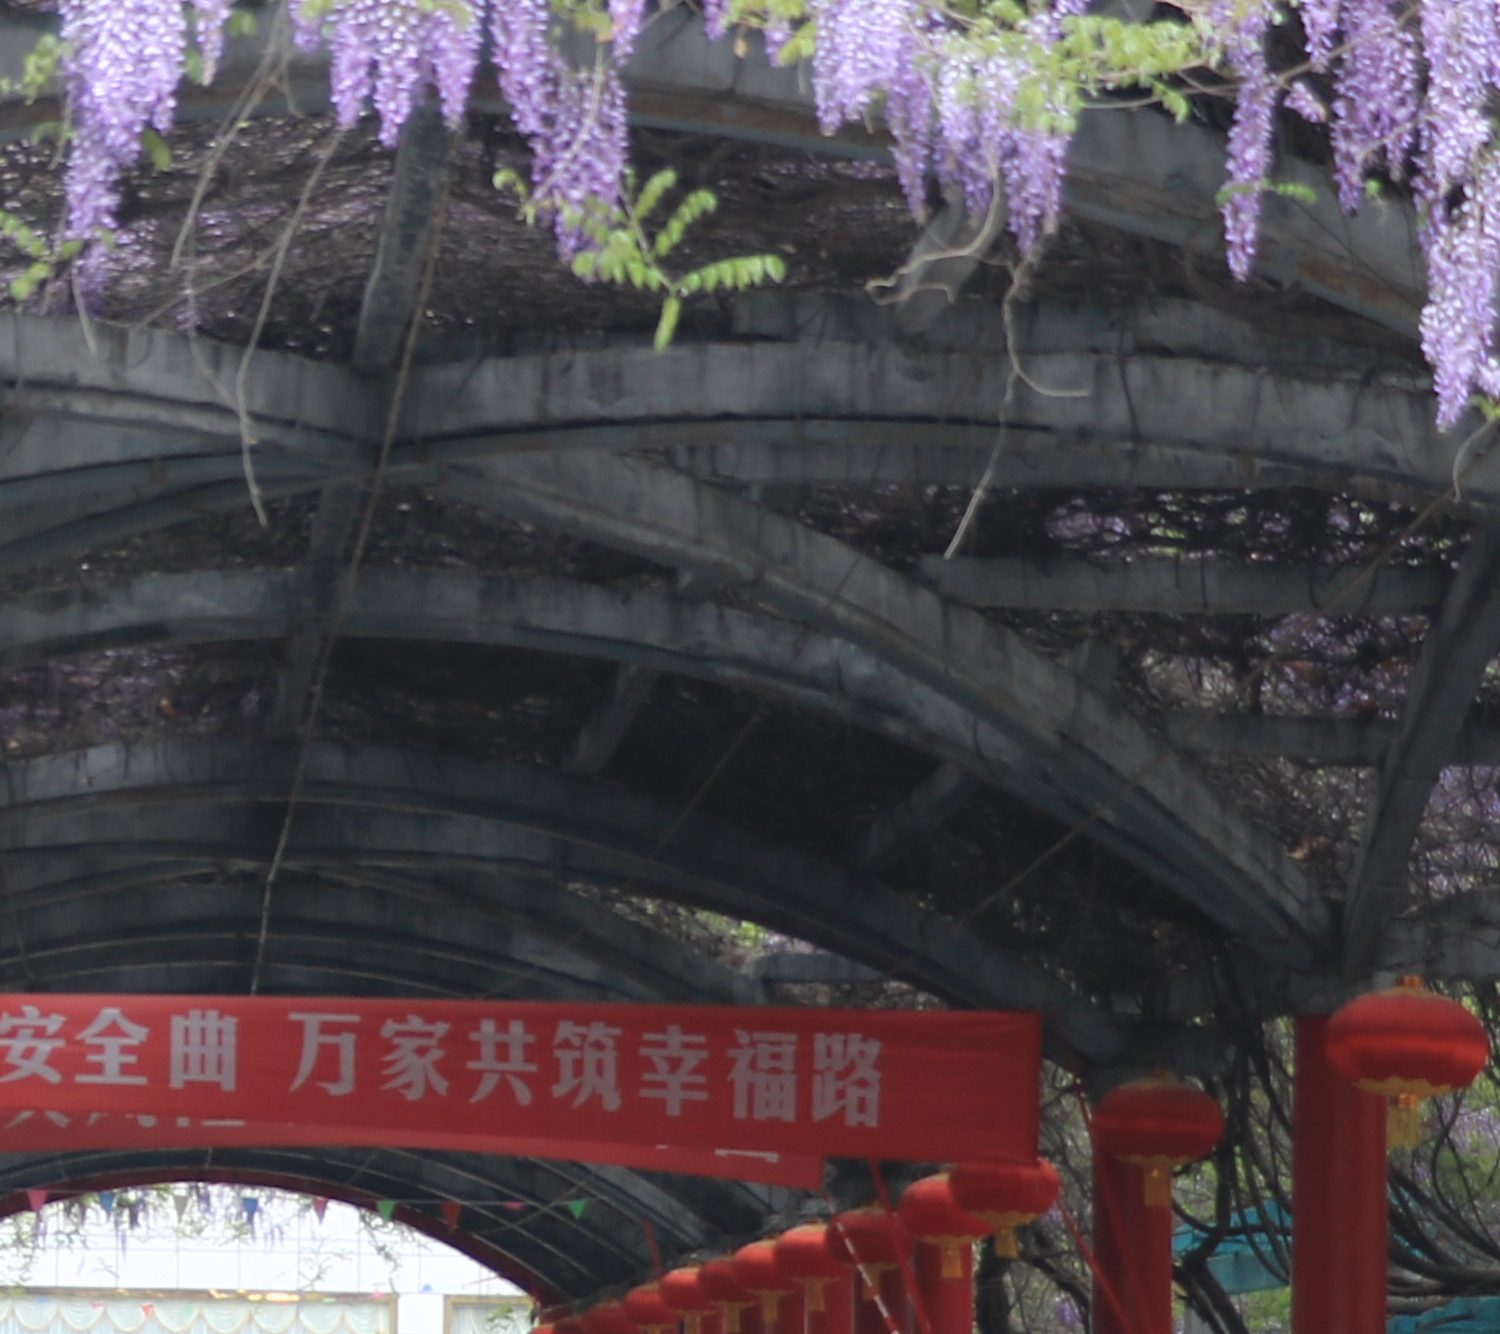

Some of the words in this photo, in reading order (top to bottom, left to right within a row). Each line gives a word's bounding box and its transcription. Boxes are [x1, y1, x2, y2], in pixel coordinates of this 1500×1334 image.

[287, 1012, 883, 1128] 万家共筑幸福路
